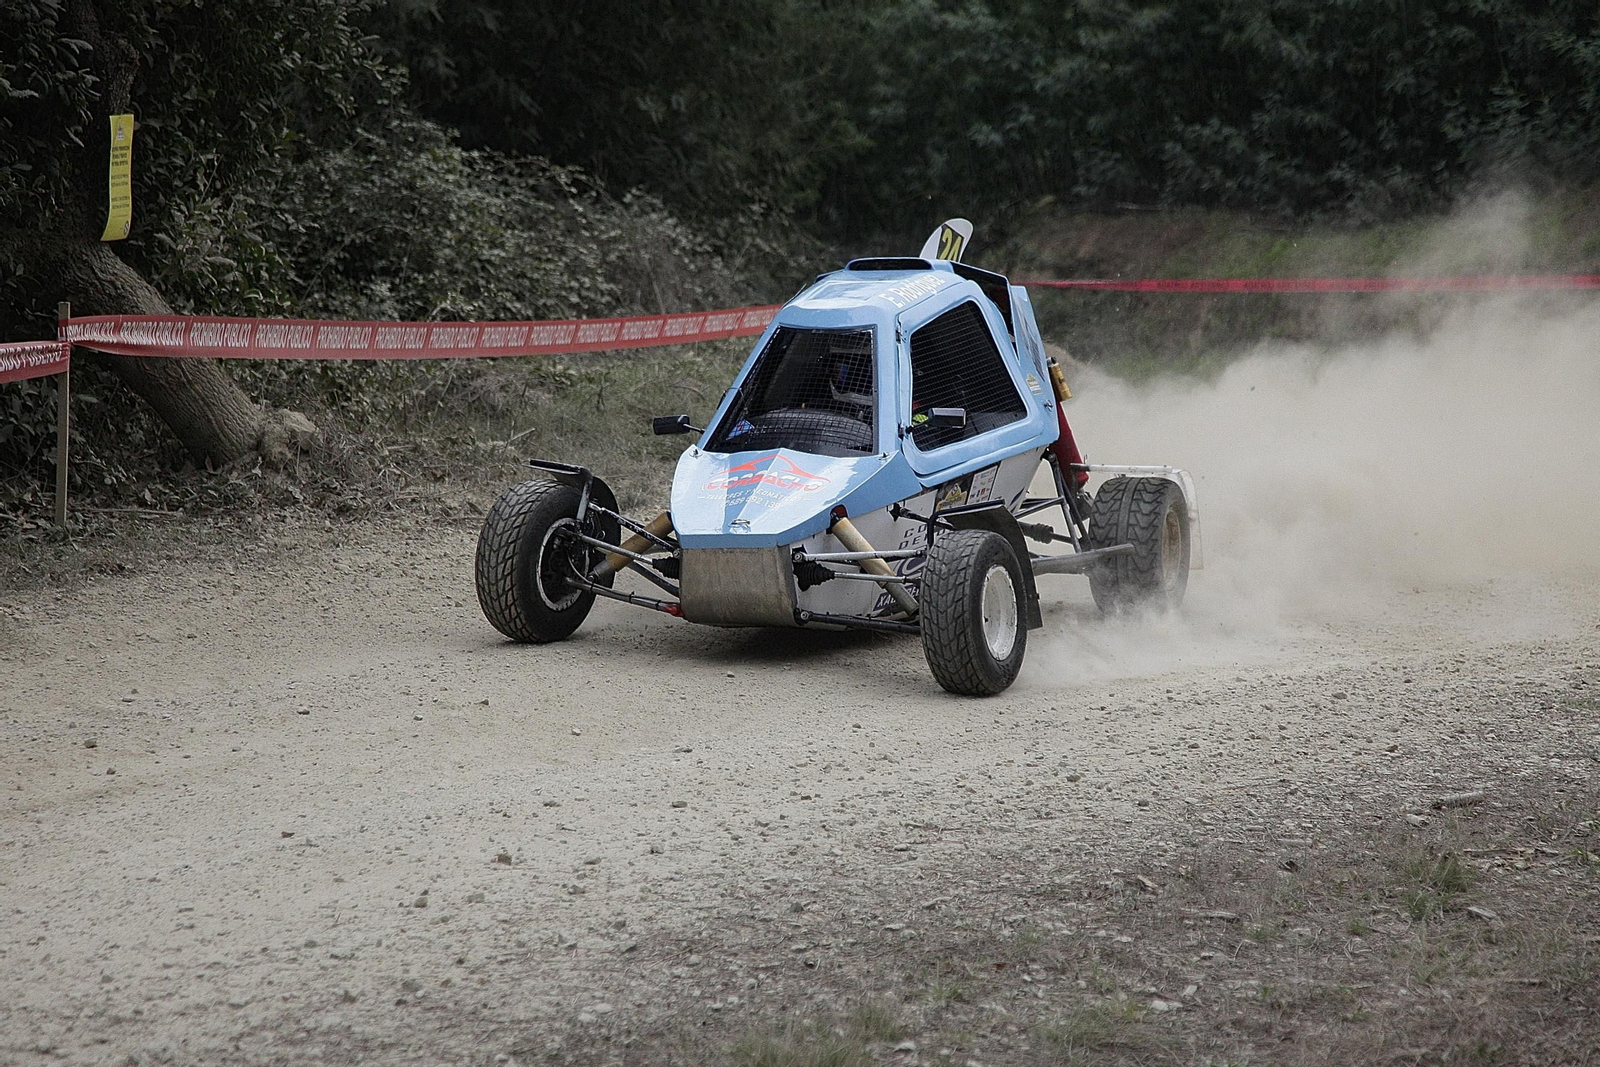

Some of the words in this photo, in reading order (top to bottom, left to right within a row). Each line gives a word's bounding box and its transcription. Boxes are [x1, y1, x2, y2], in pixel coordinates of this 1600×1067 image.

[120, 321, 156, 345] PROHIBIDO
[156, 321, 186, 346] PUBLICO
[190, 322, 225, 347] PROHIBIDO
[223, 322, 252, 348] PUBLICO
[255, 324, 289, 348] PROHIBIDO
[286, 325, 314, 349] PUBLICO
[316, 325, 349, 349] PROHIBIDO
[346, 326, 372, 349] PUBLICO
[20, 344, 63, 368] PUBLICO
[706, 470, 824, 492] CORBACHO
